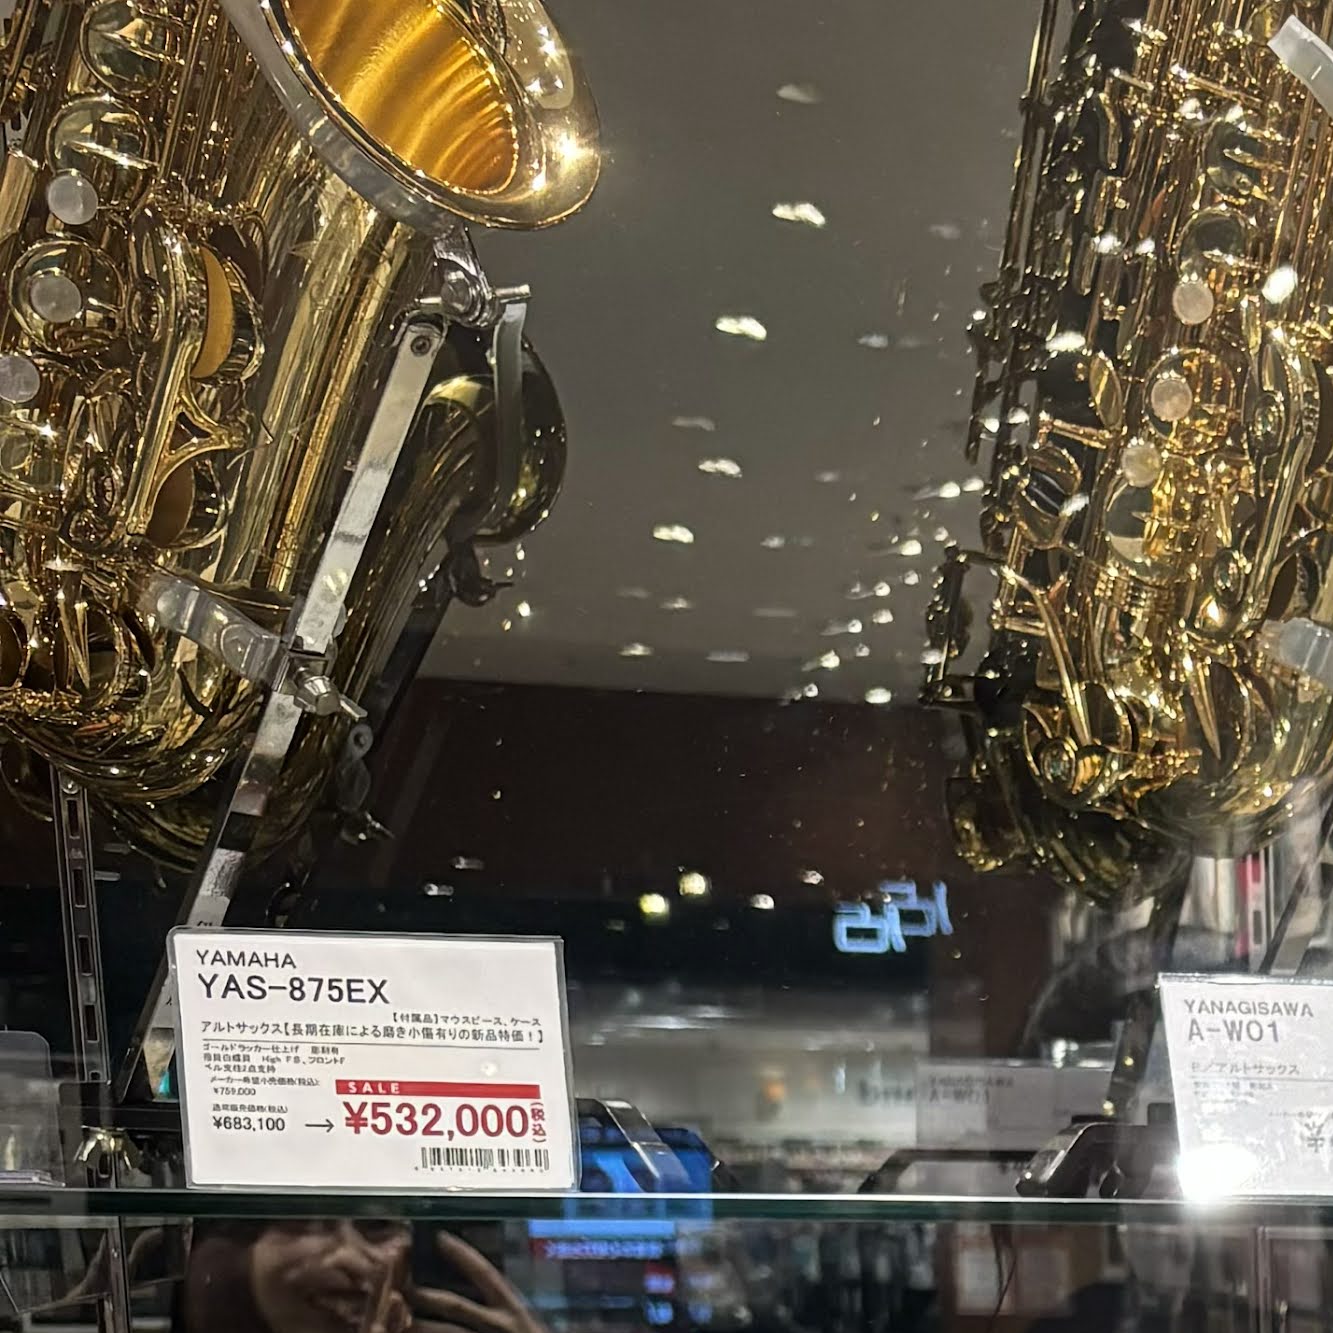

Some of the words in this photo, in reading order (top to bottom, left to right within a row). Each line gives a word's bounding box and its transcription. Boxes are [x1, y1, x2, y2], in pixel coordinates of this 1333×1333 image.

[196, 949, 297, 969] YAMAHA
[197, 973, 390, 1005] YAS-875EX
[1184, 999, 1314, 1018] YANAGISAWA
[347, 1081, 400, 1095] SALE
[212, 1115, 286, 1132] ¥683,100
[342, 1100, 529, 1141] ¥532,000
